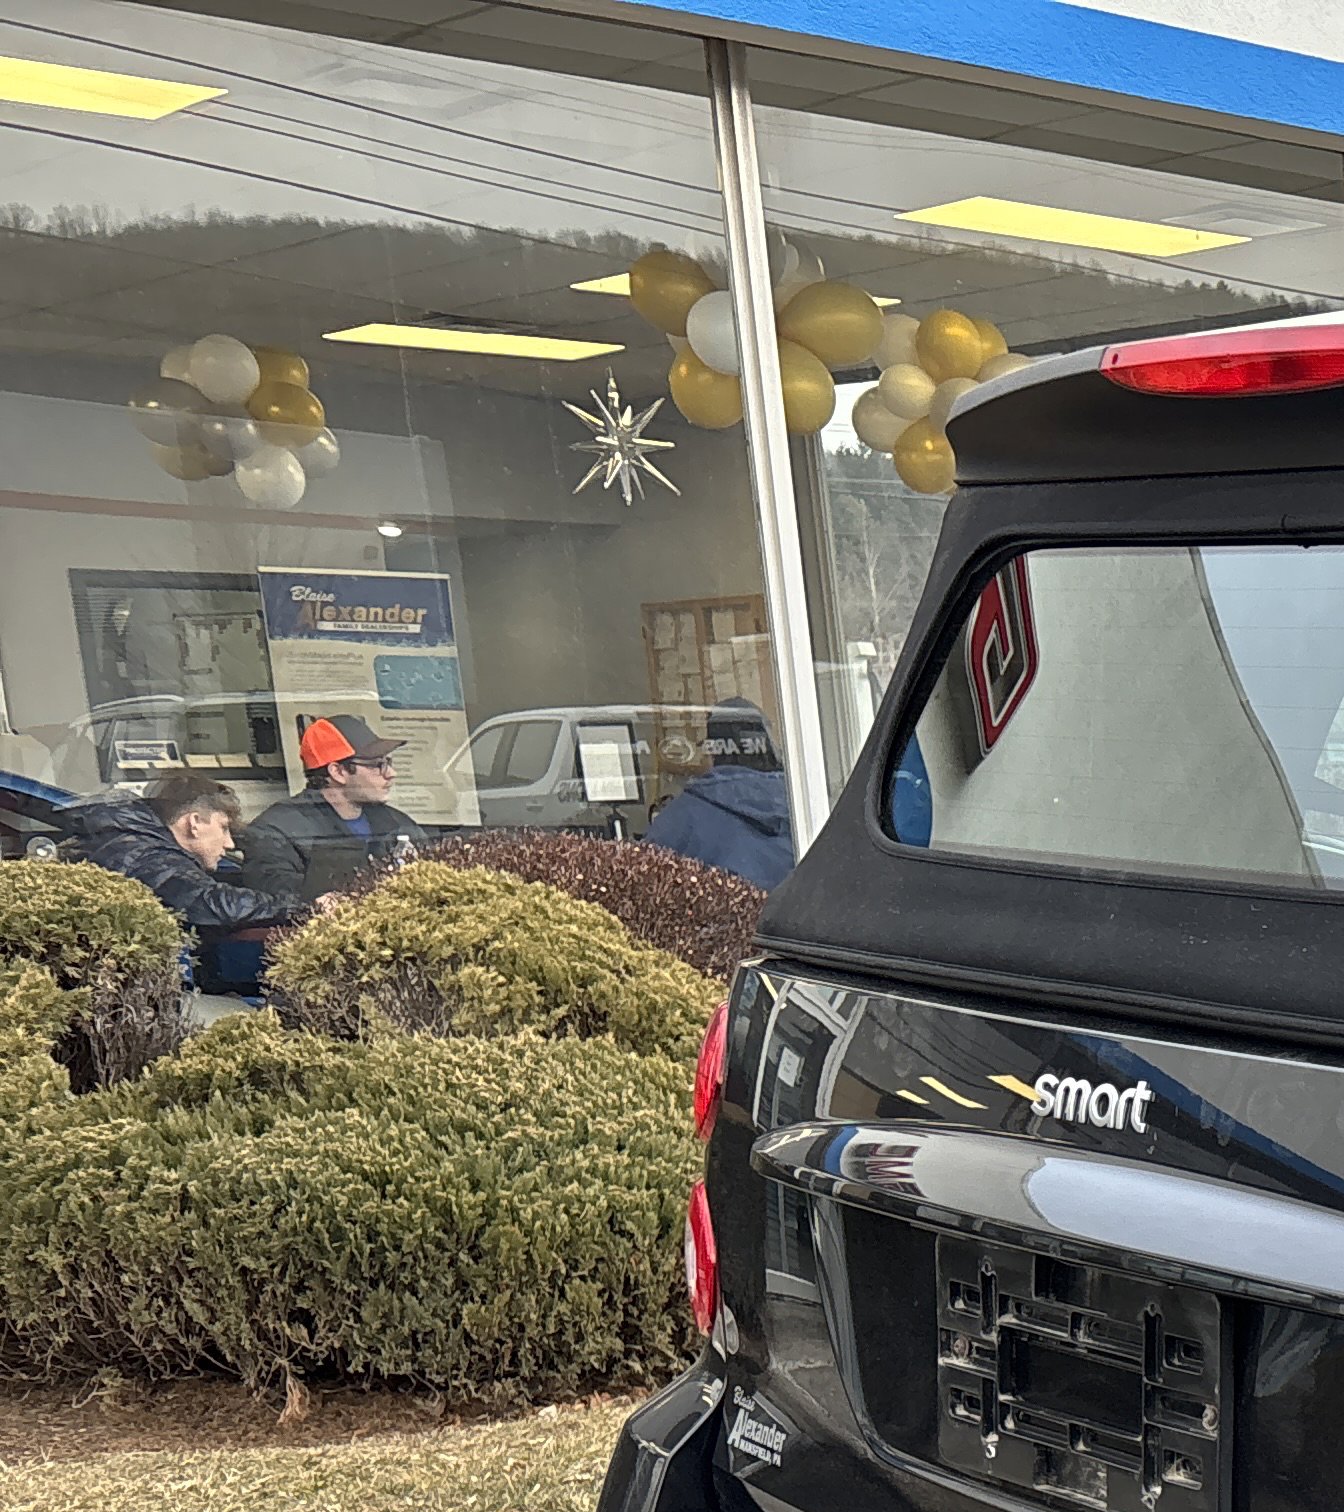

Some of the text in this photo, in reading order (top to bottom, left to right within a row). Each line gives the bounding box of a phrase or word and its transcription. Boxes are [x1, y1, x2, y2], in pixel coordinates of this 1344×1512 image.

[289, 585, 336, 602] Blaise
[297, 601, 428, 630] Alexander
[1030, 1073, 1150, 1134] smart
[726, 1407, 787, 1453] Alexander
